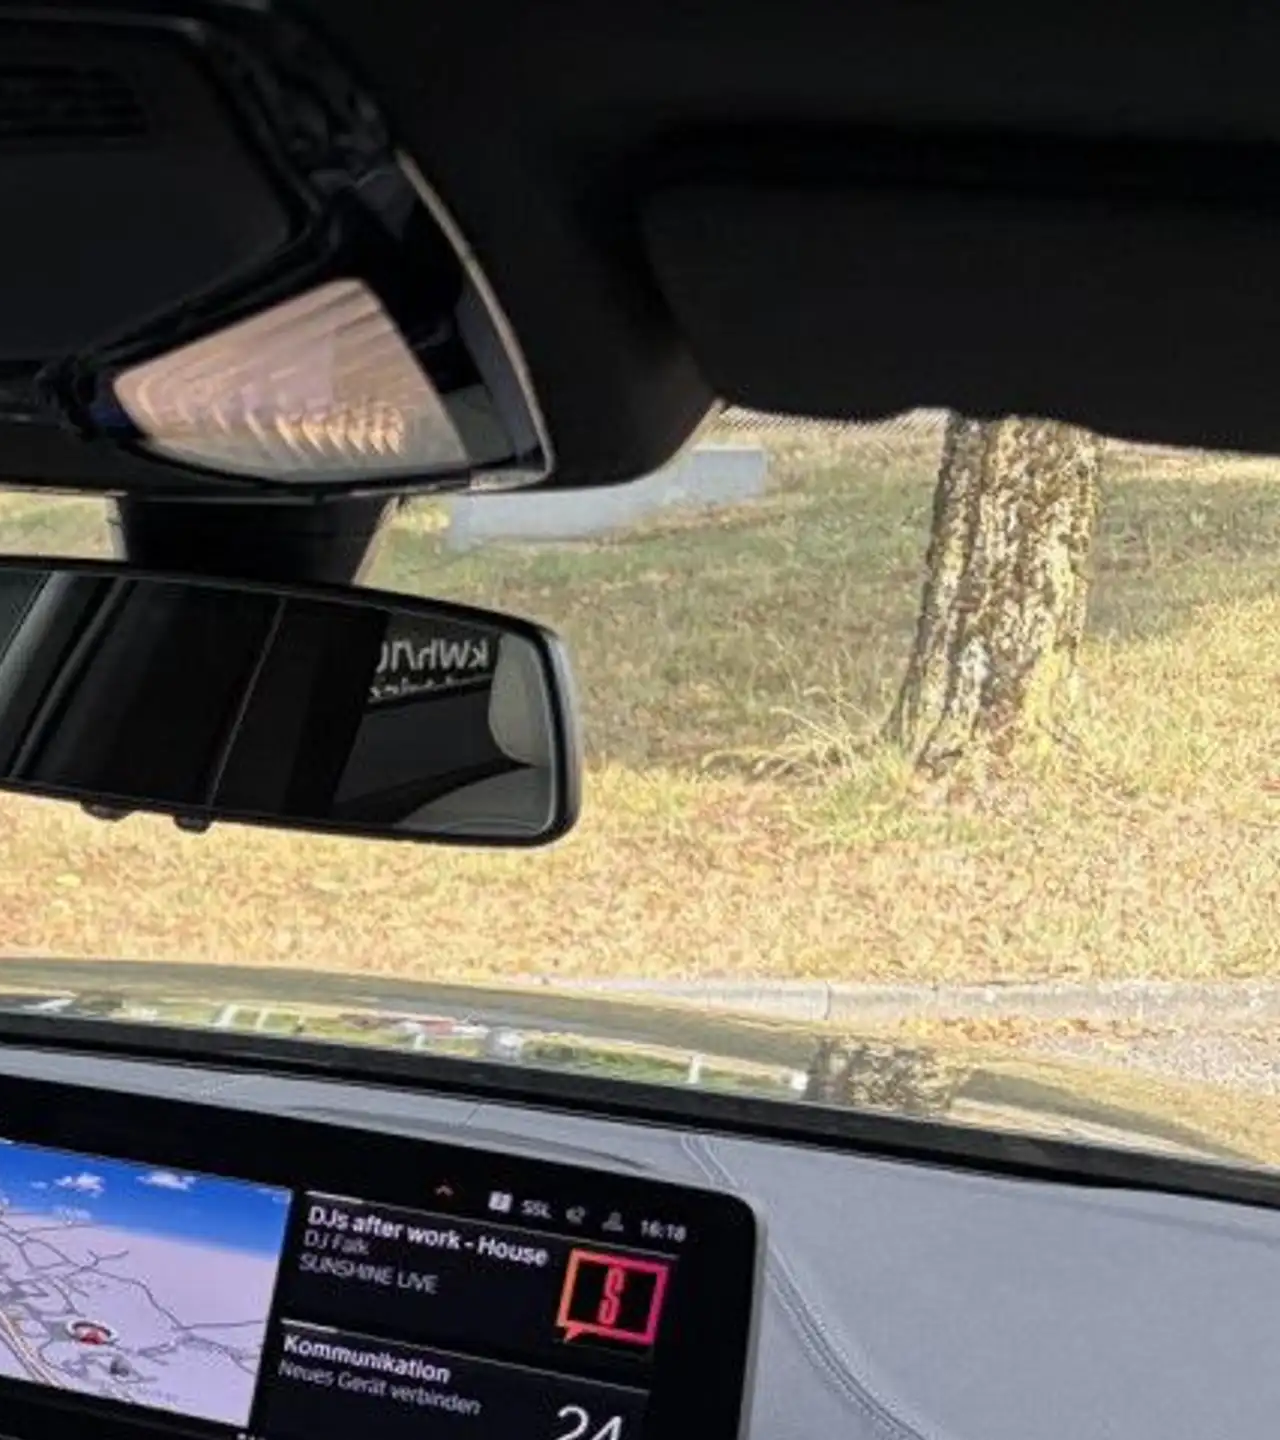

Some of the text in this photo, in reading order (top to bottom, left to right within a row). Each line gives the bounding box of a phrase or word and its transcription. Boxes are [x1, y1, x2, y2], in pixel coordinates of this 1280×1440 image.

[303, 1229, 370, 1256] DJ Falk
[307, 1205, 350, 1231] DJs
[353, 1214, 403, 1242] after
[407, 1226, 461, 1250] work
[477, 1235, 549, 1267] House
[299, 1254, 440, 1296] SUNSHINE LIVE
[283, 1333, 452, 1385] Kommunikation
[278, 1358, 335, 1388] Neues
[390, 1383, 482, 1416] verbinden
